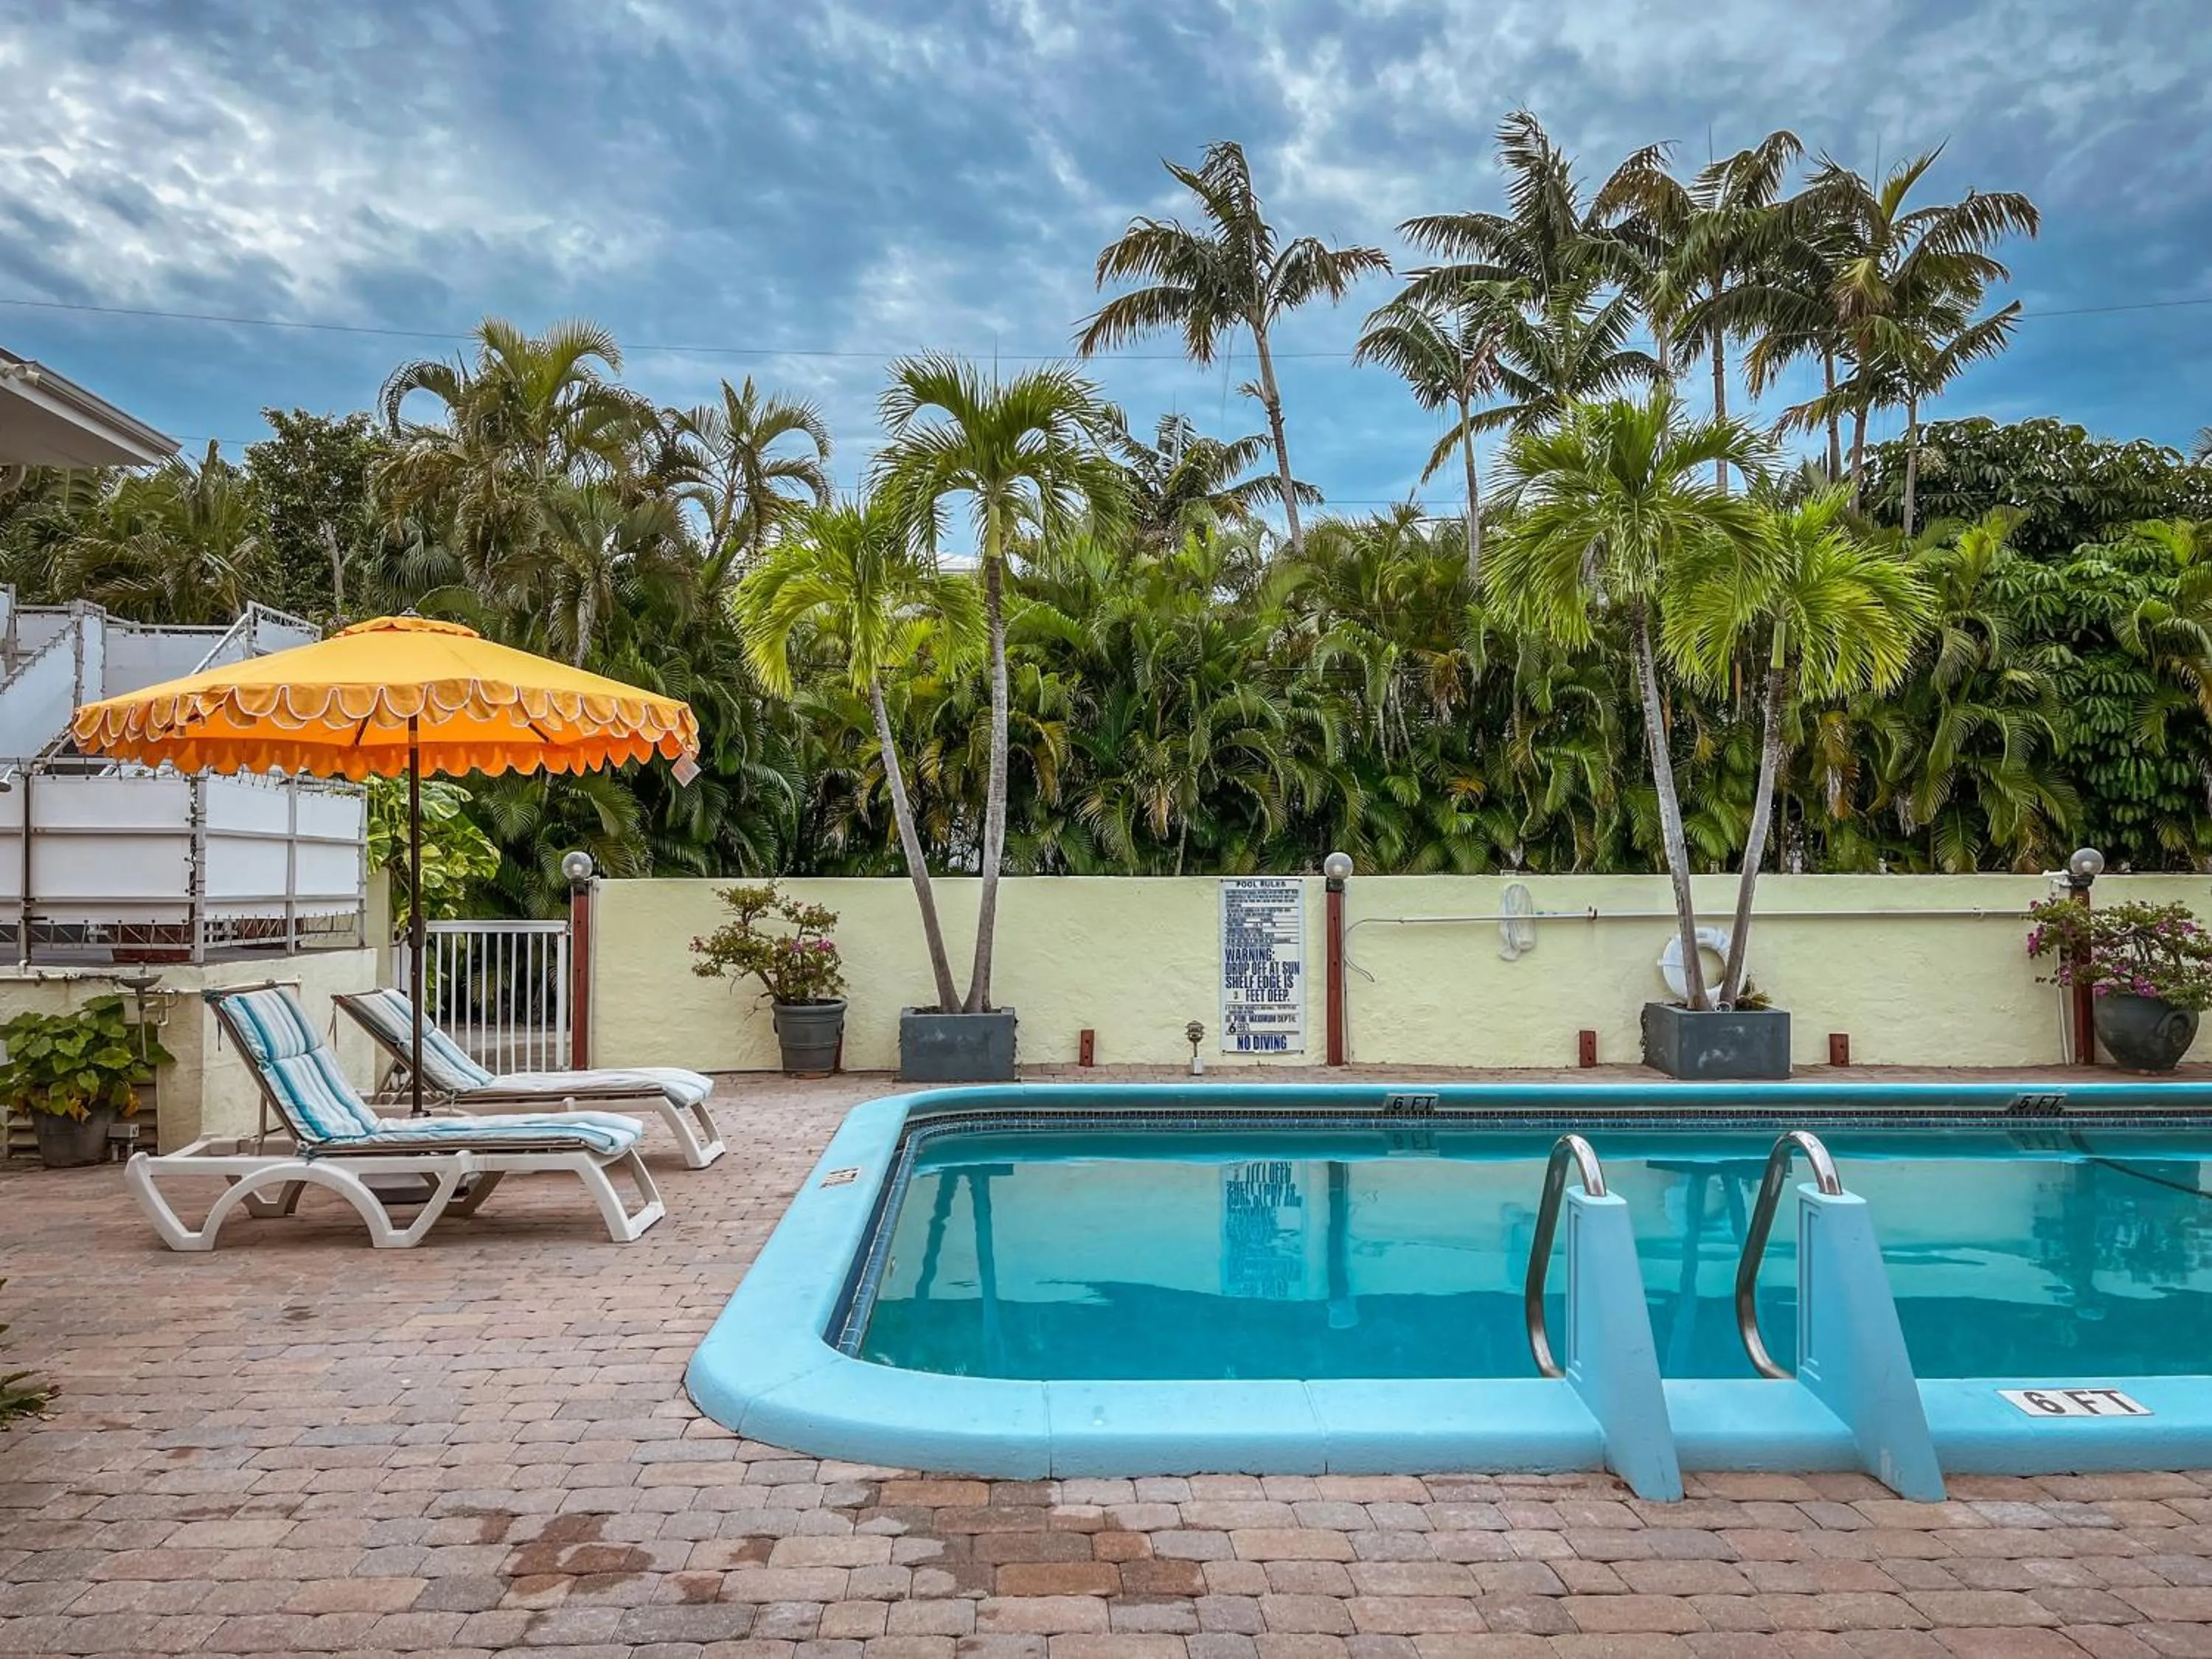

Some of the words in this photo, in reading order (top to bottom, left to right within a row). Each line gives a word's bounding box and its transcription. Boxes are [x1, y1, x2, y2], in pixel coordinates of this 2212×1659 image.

[1225, 948, 1275, 961] WARNING:
[1225, 961, 1250, 975] DROP
[1251, 961, 1267, 975] OFF
[1270, 961, 1279, 975] AT
[1282, 961, 1300, 975] SUN
[1225, 975, 1255, 989] SHELF
[1257, 975, 1281, 989] EDGE
[1284, 975, 1294, 988] IS
[1245, 989, 1265, 1001] FEET
[1267, 989, 1290, 1001] DEEP.
[1228, 1023, 1237, 1034] 6
[1237, 1035, 1251, 1050] NO
[1253, 1035, 1287, 1050] DIVING
[1393, 1096, 1405, 1110] 6
[1411, 1096, 1436, 1110] FT
[2019, 1096, 2032, 1110] 5
[2037, 1096, 2065, 1110] FT
[2023, 1391, 2066, 1413] 6
[2063, 1391, 2137, 1414] FT
